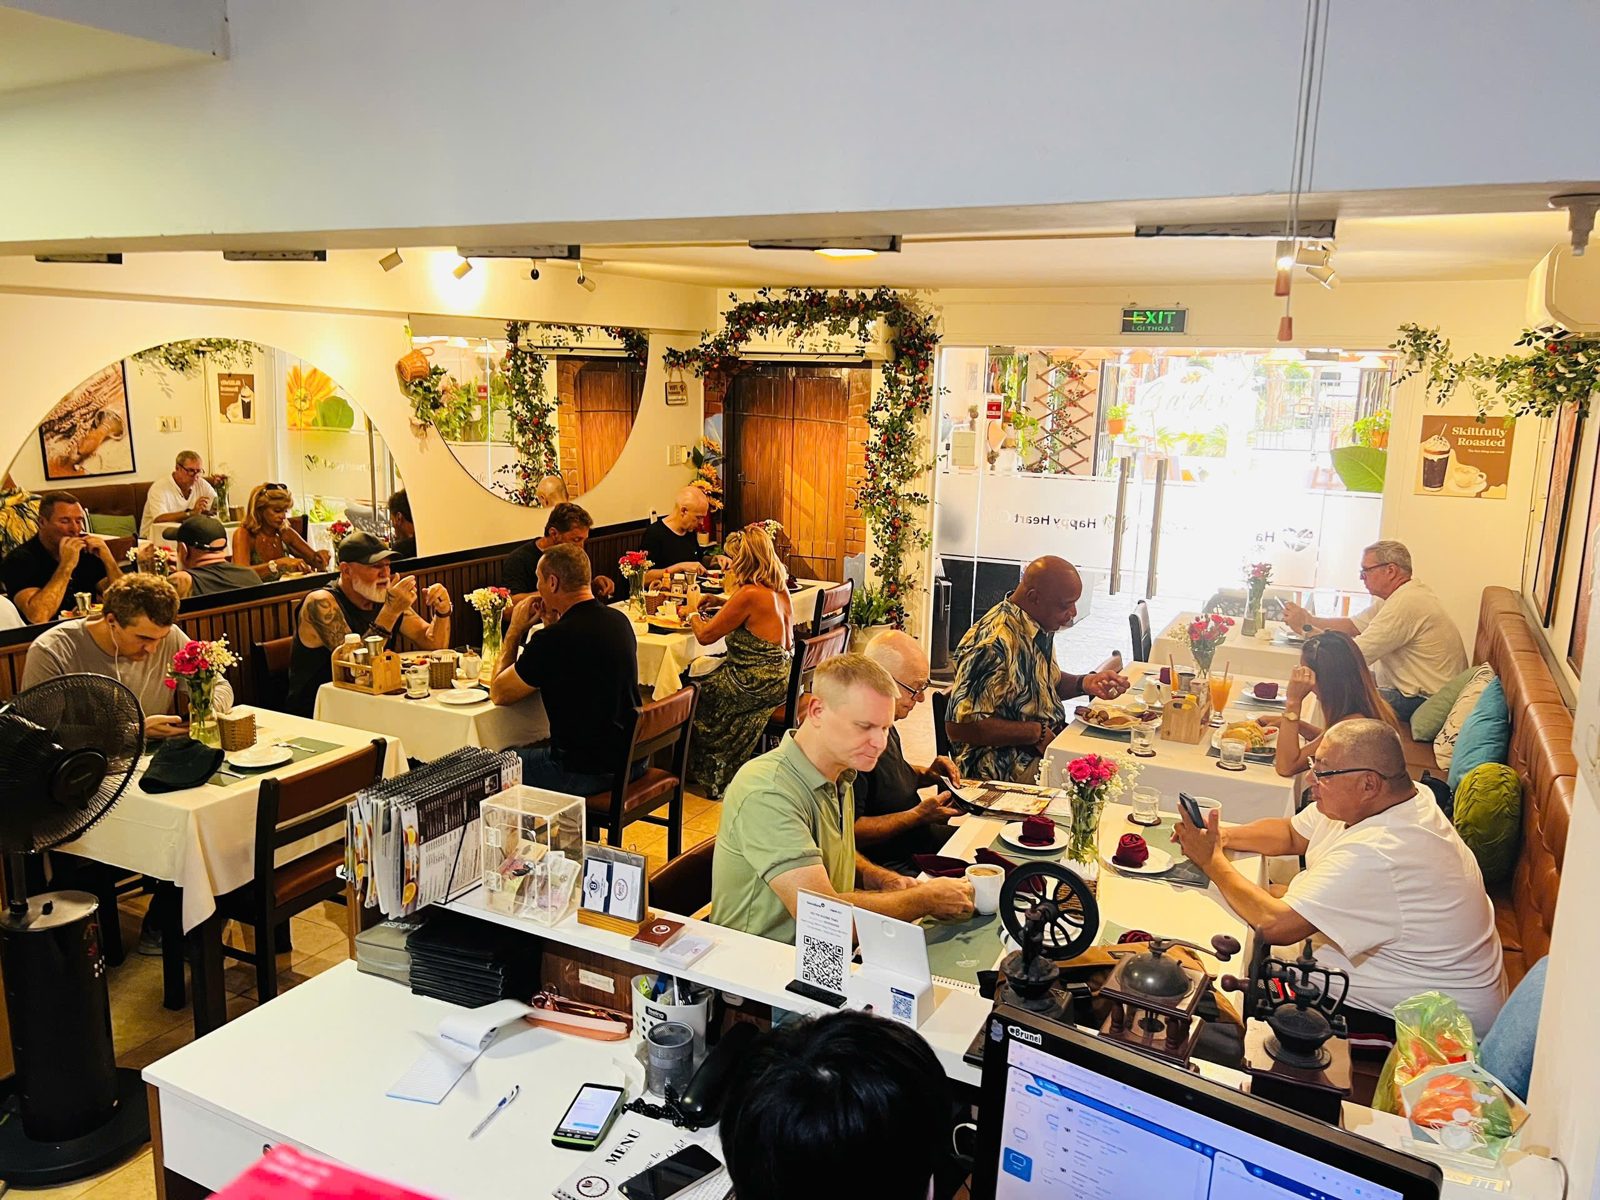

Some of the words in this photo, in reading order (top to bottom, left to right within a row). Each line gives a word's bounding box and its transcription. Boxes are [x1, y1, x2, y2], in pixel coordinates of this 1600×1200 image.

[1132, 311, 1176, 324] EXIT
[1452, 426, 1507, 438] Skillfully
[1457, 437, 1505, 447] Roasted
[605, 1129, 641, 1166] MENU
